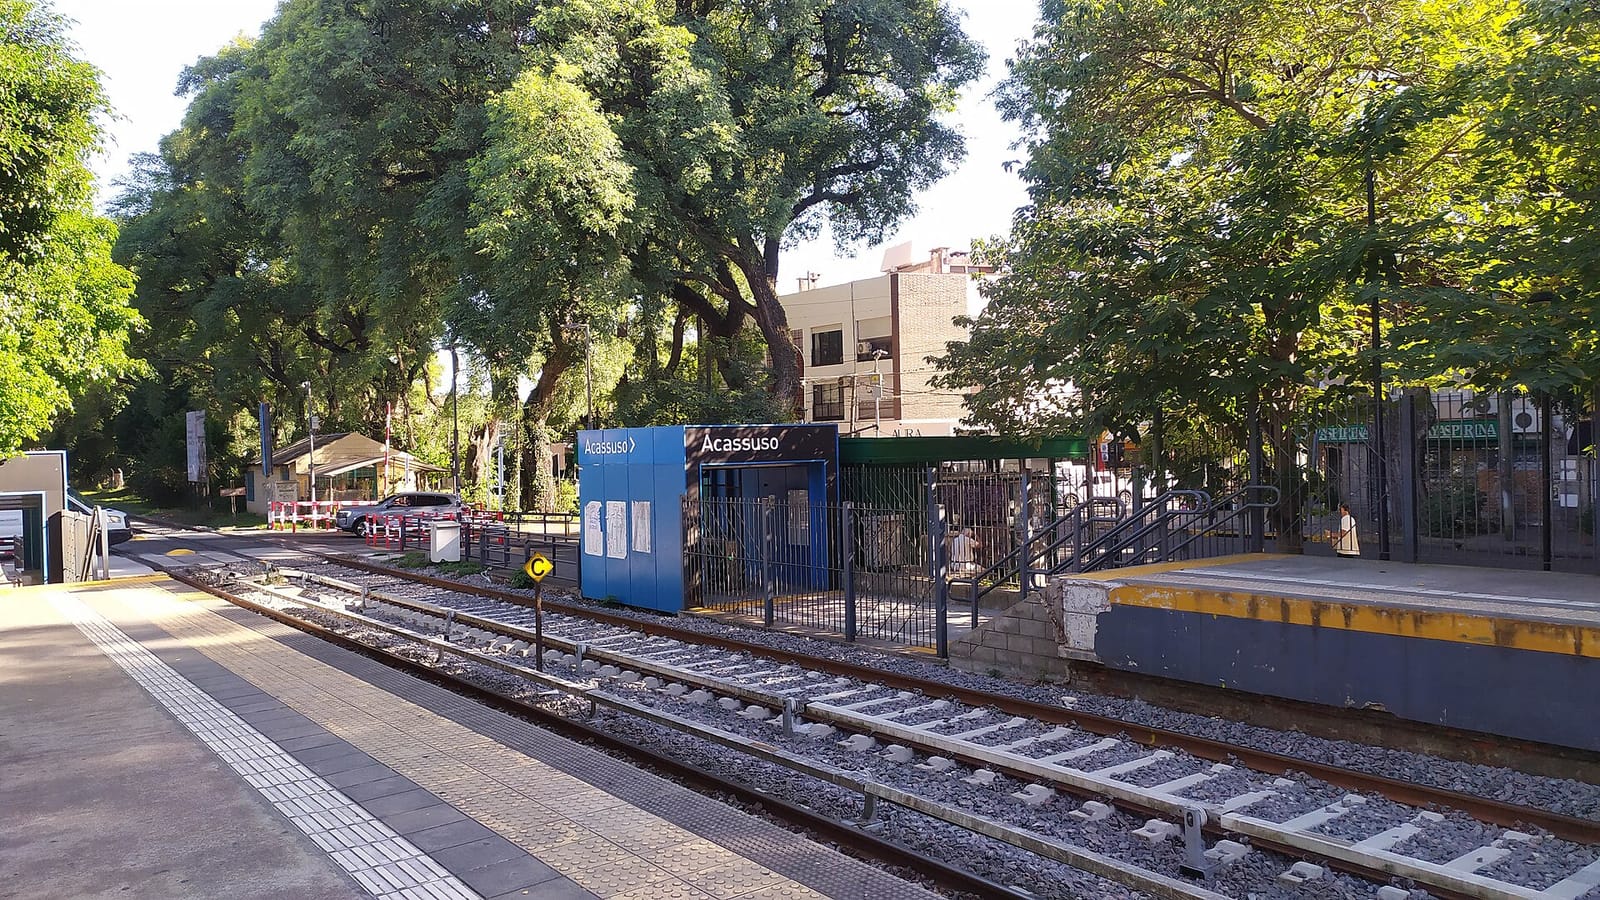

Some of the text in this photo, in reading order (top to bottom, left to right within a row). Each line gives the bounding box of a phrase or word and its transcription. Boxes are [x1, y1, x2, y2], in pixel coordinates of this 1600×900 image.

[584, 439, 628, 455] Acassuso
[701, 434, 779, 453] Acassuso
[531, 558, 545, 576] C
